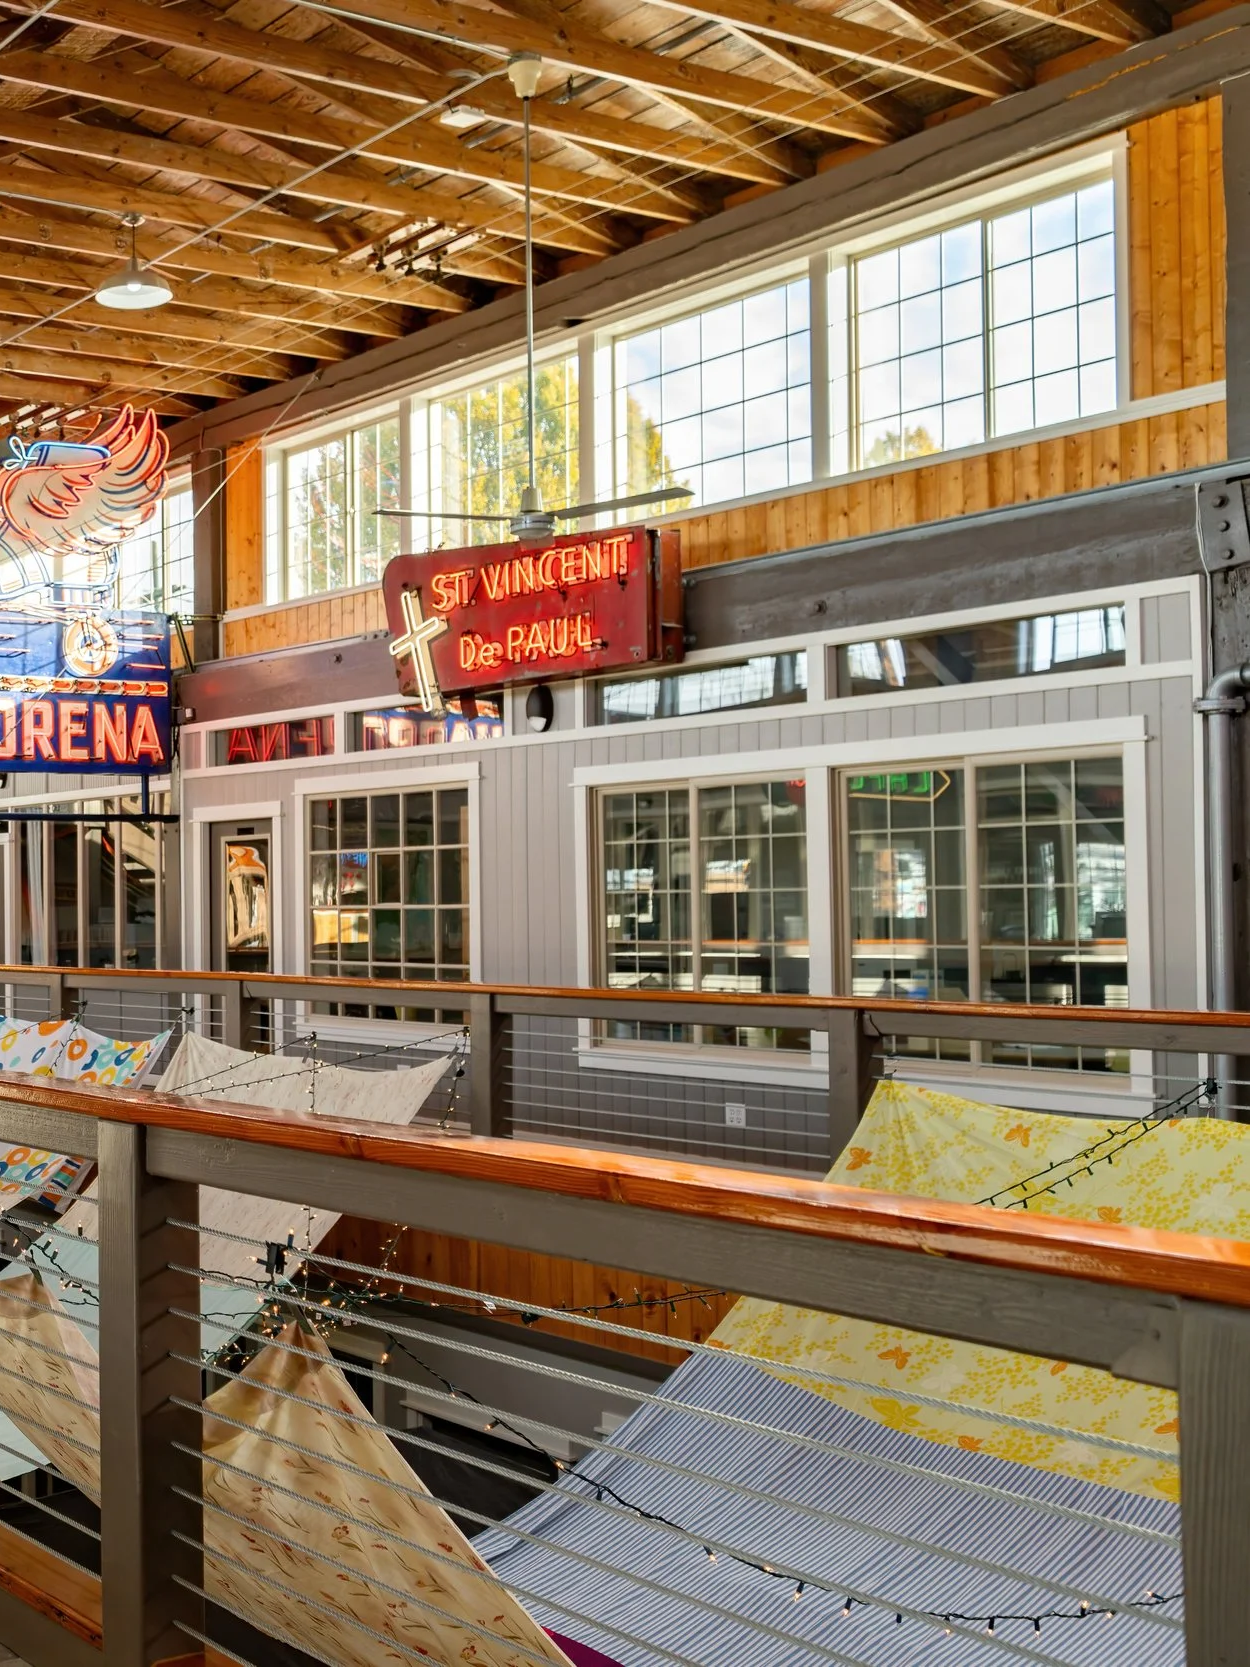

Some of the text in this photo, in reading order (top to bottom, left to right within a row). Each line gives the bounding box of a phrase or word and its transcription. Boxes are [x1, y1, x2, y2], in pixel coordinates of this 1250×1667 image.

[480, 532, 634, 603] VINCENT
[459, 611, 603, 672] De PAUL
